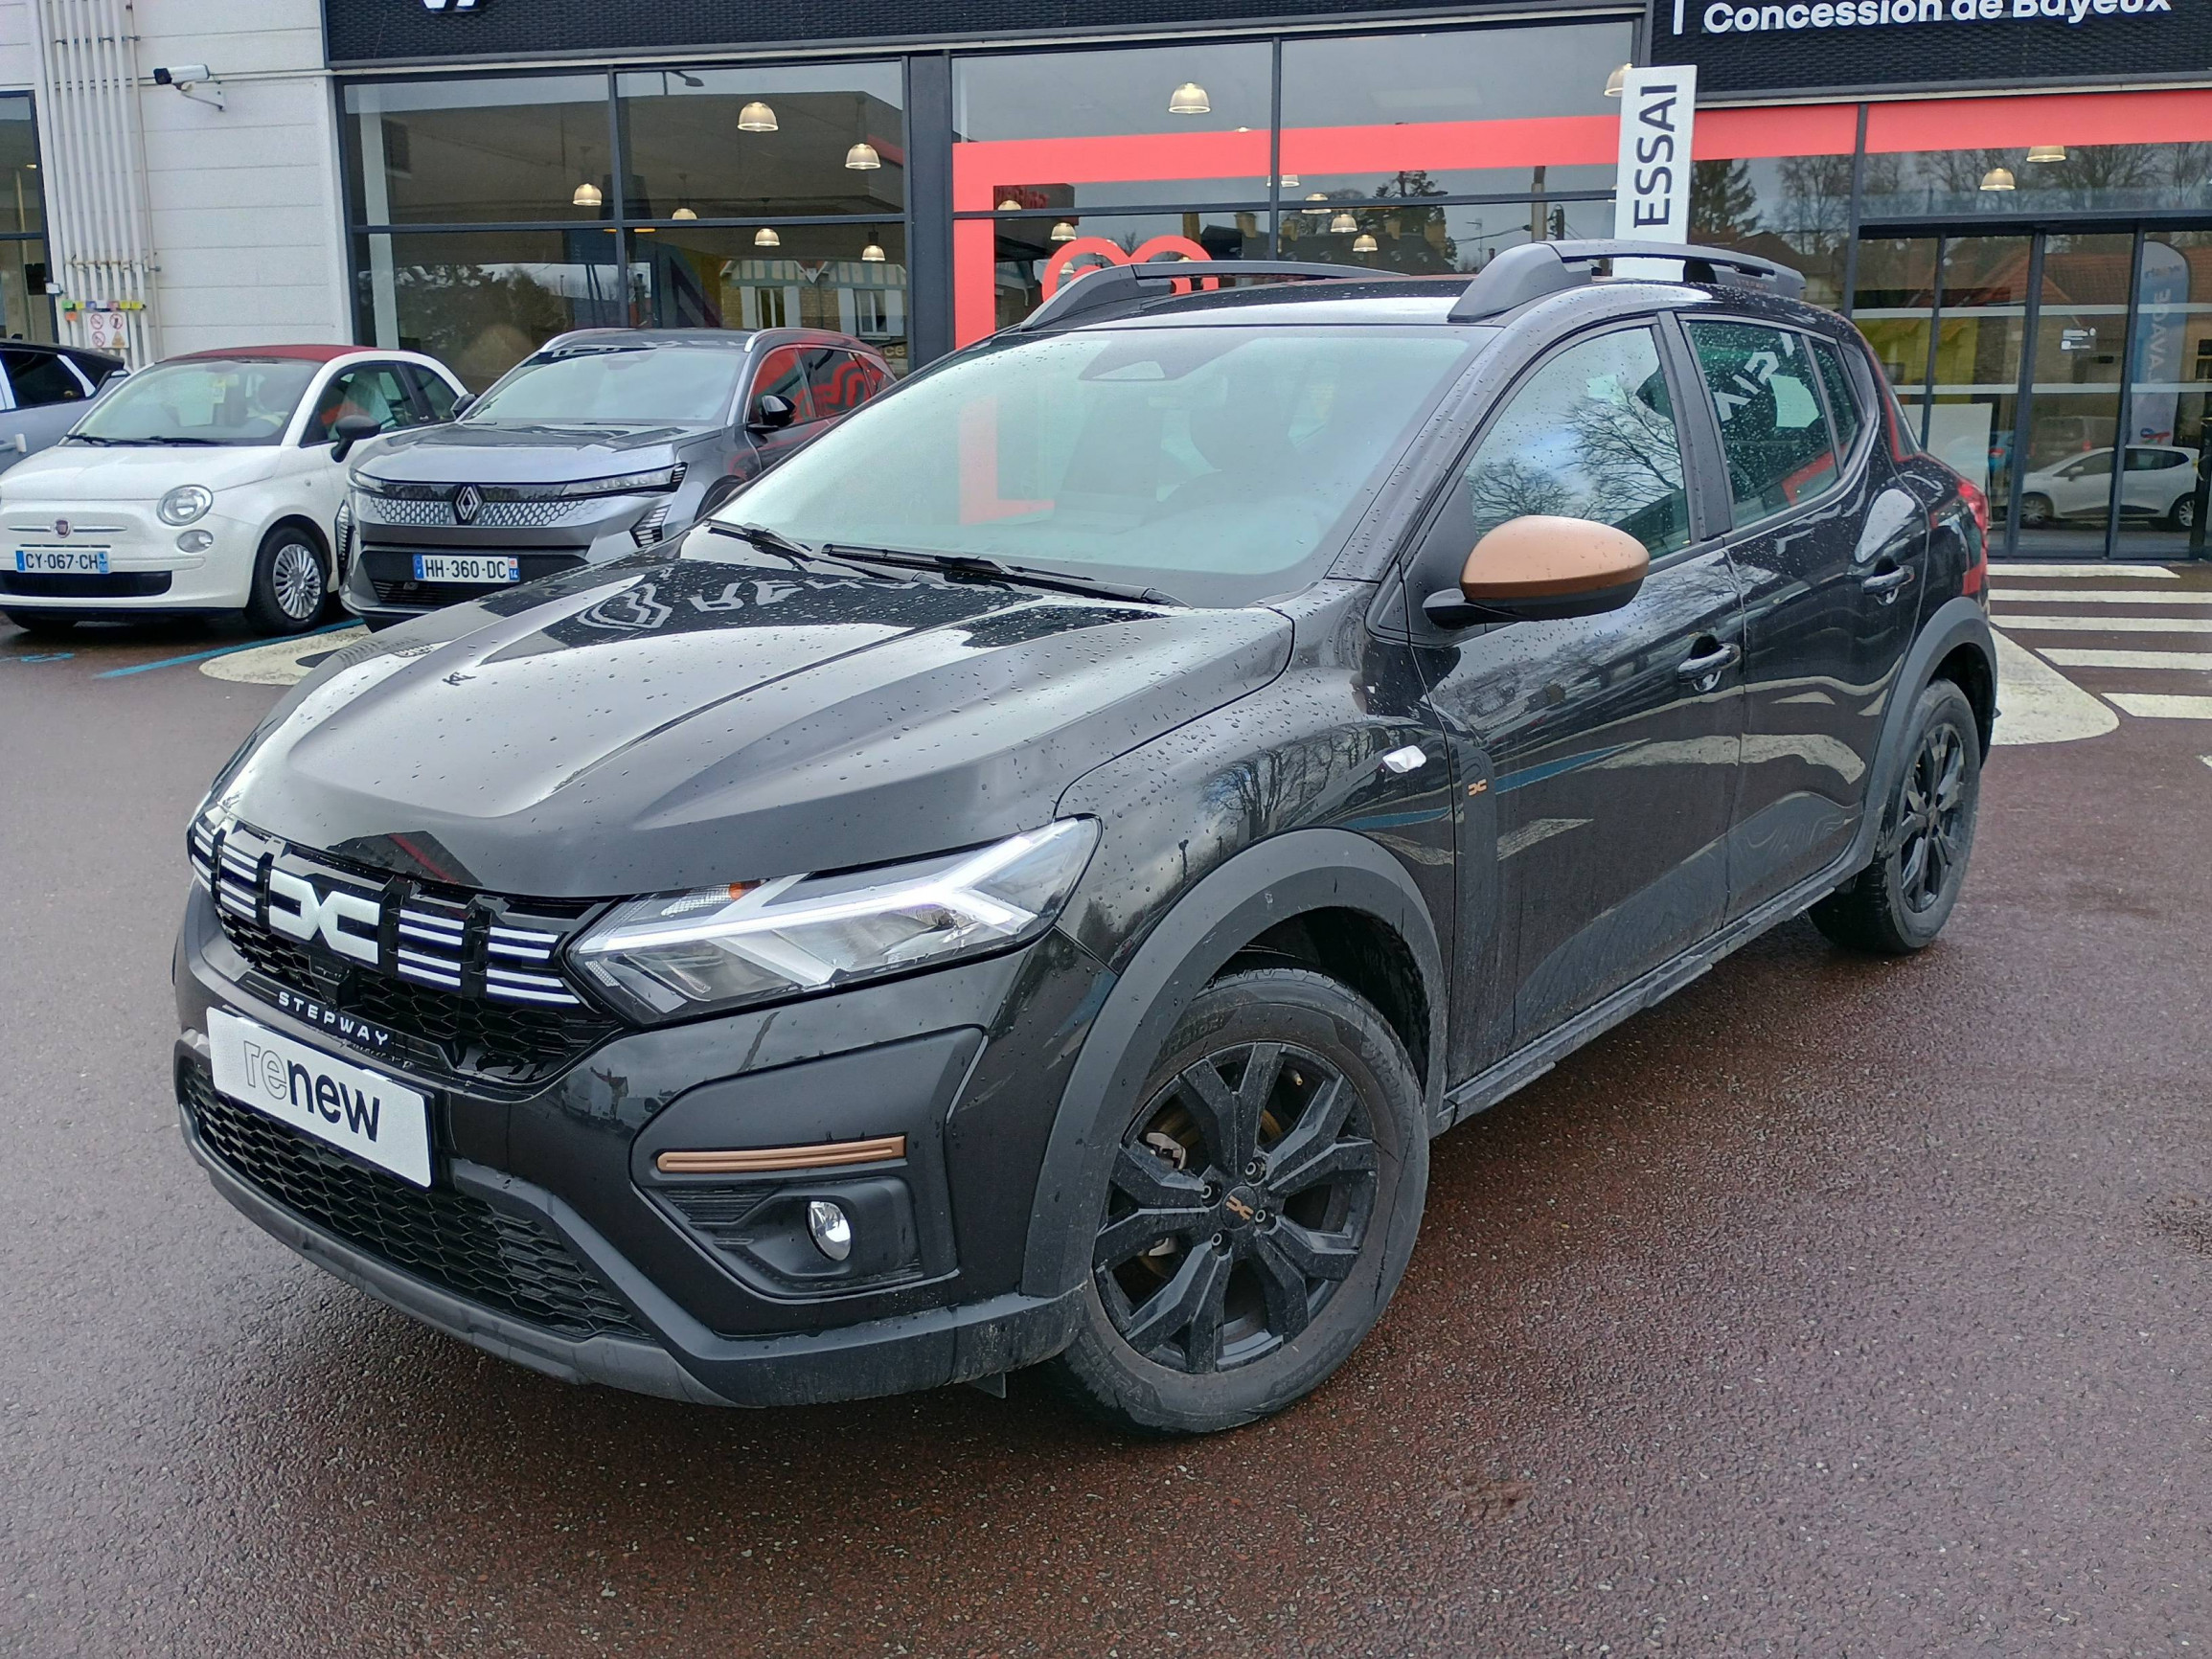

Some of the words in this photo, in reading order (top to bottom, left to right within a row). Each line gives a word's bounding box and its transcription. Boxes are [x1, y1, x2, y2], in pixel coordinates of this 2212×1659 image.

[1703, 0, 1943, 34] Concession
[1950, 0, 2004, 20] de
[1632, 84, 1677, 229] ESSAI
[25, 553, 99, 570] CY-067-CH
[424, 558, 507, 579] HH-360-DC
[278, 990, 389, 1046] STEPWAY
[243, 1039, 381, 1143] renew
